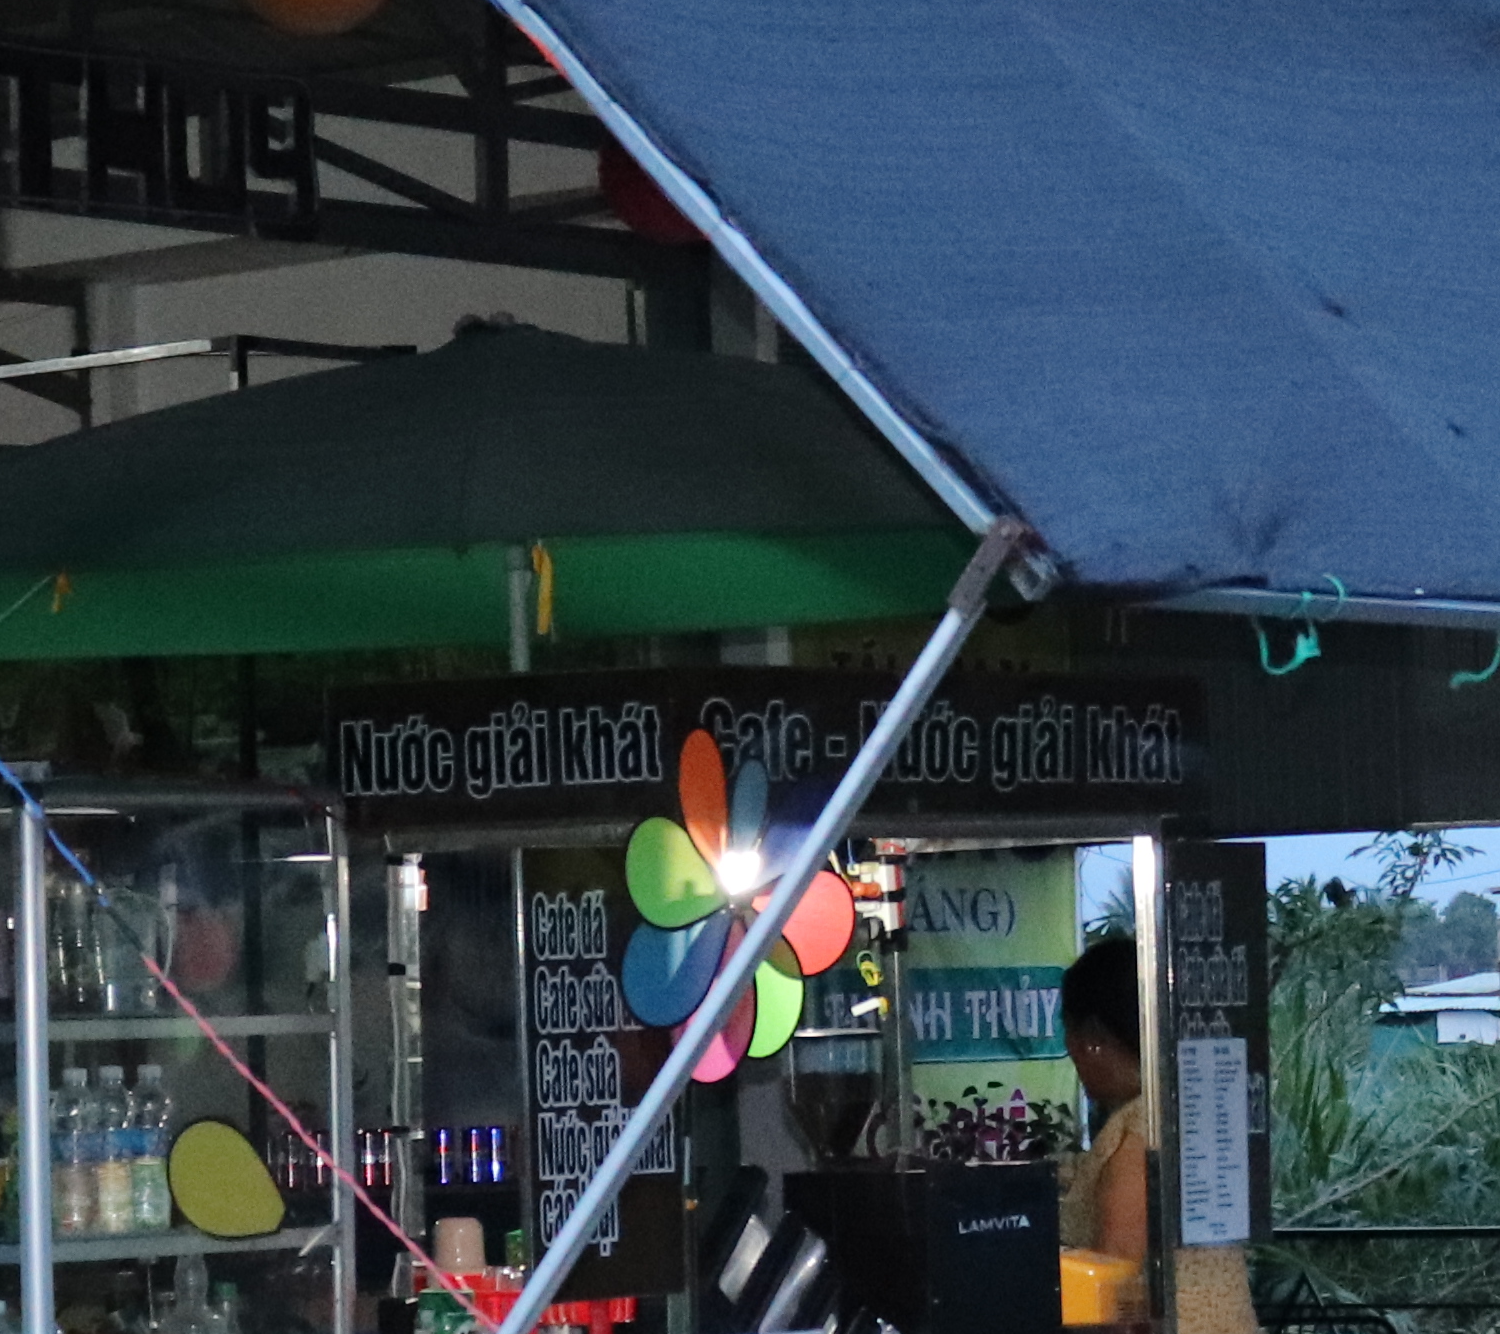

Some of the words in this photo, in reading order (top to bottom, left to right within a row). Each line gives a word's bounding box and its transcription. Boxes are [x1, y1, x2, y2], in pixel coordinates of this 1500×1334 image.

[341, 715, 453, 796] Nước
[465, 701, 550, 798] giải
[562, 703, 662, 784] khát
[992, 696, 1073, 790] giải
[1087, 704, 1181, 783] khát
[532, 892, 578, 961] Cafe
[578, 890, 607, 960] đá
[534, 966, 580, 1034] Cafe
[536, 1039, 581, 1108] Cafe
[538, 1110, 588, 1181] Nước
[958, 1214, 1030, 1234] LAMVITA
